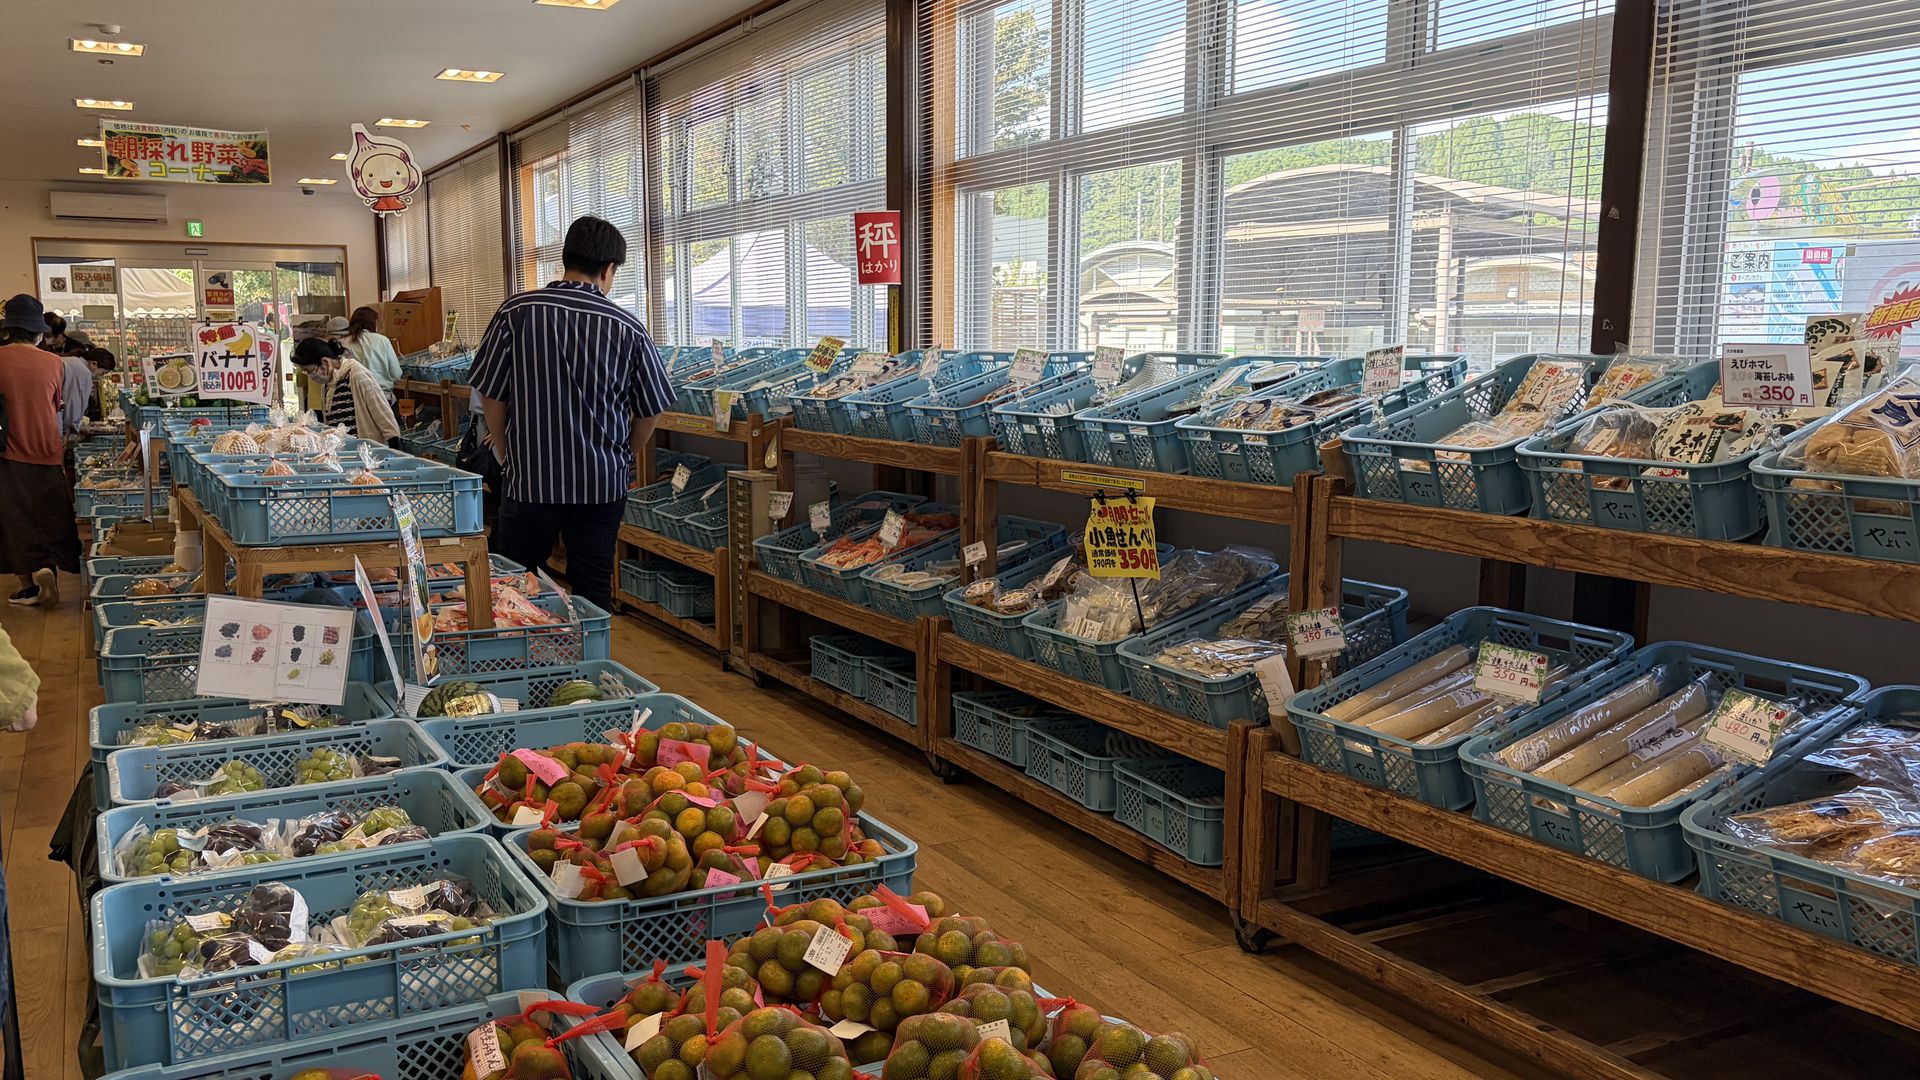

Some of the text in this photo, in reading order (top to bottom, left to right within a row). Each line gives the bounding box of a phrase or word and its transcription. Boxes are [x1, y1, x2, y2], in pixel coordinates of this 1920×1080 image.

[112, 136, 241, 166] 朝採れ野菜
[150, 162, 232, 181] コーナー
[859, 222, 898, 259] 秤
[861, 260, 897, 274] はかり
[1868, 300, 1920, 326] 新商品
[201, 350, 256, 368] バナナ
[1731, 359, 1773, 369] えびホマレ
[220, 370, 257, 391] 100円
[1754, 372, 1795, 381] 海苔しお味
[1759, 385, 1795, 401] 350
[1800, 394, 1809, 403] 円
[1602, 501, 1638, 520] やよい
[1864, 527, 1911, 549] やよい
[1117, 548, 1158, 573] 350円
[1303, 631, 1321, 643] 350
[1492, 666, 1516, 681] 350
[1724, 721, 1750, 735] 480
[1541, 820, 1575, 842] やよい
[1792, 902, 1839, 928] やよい
